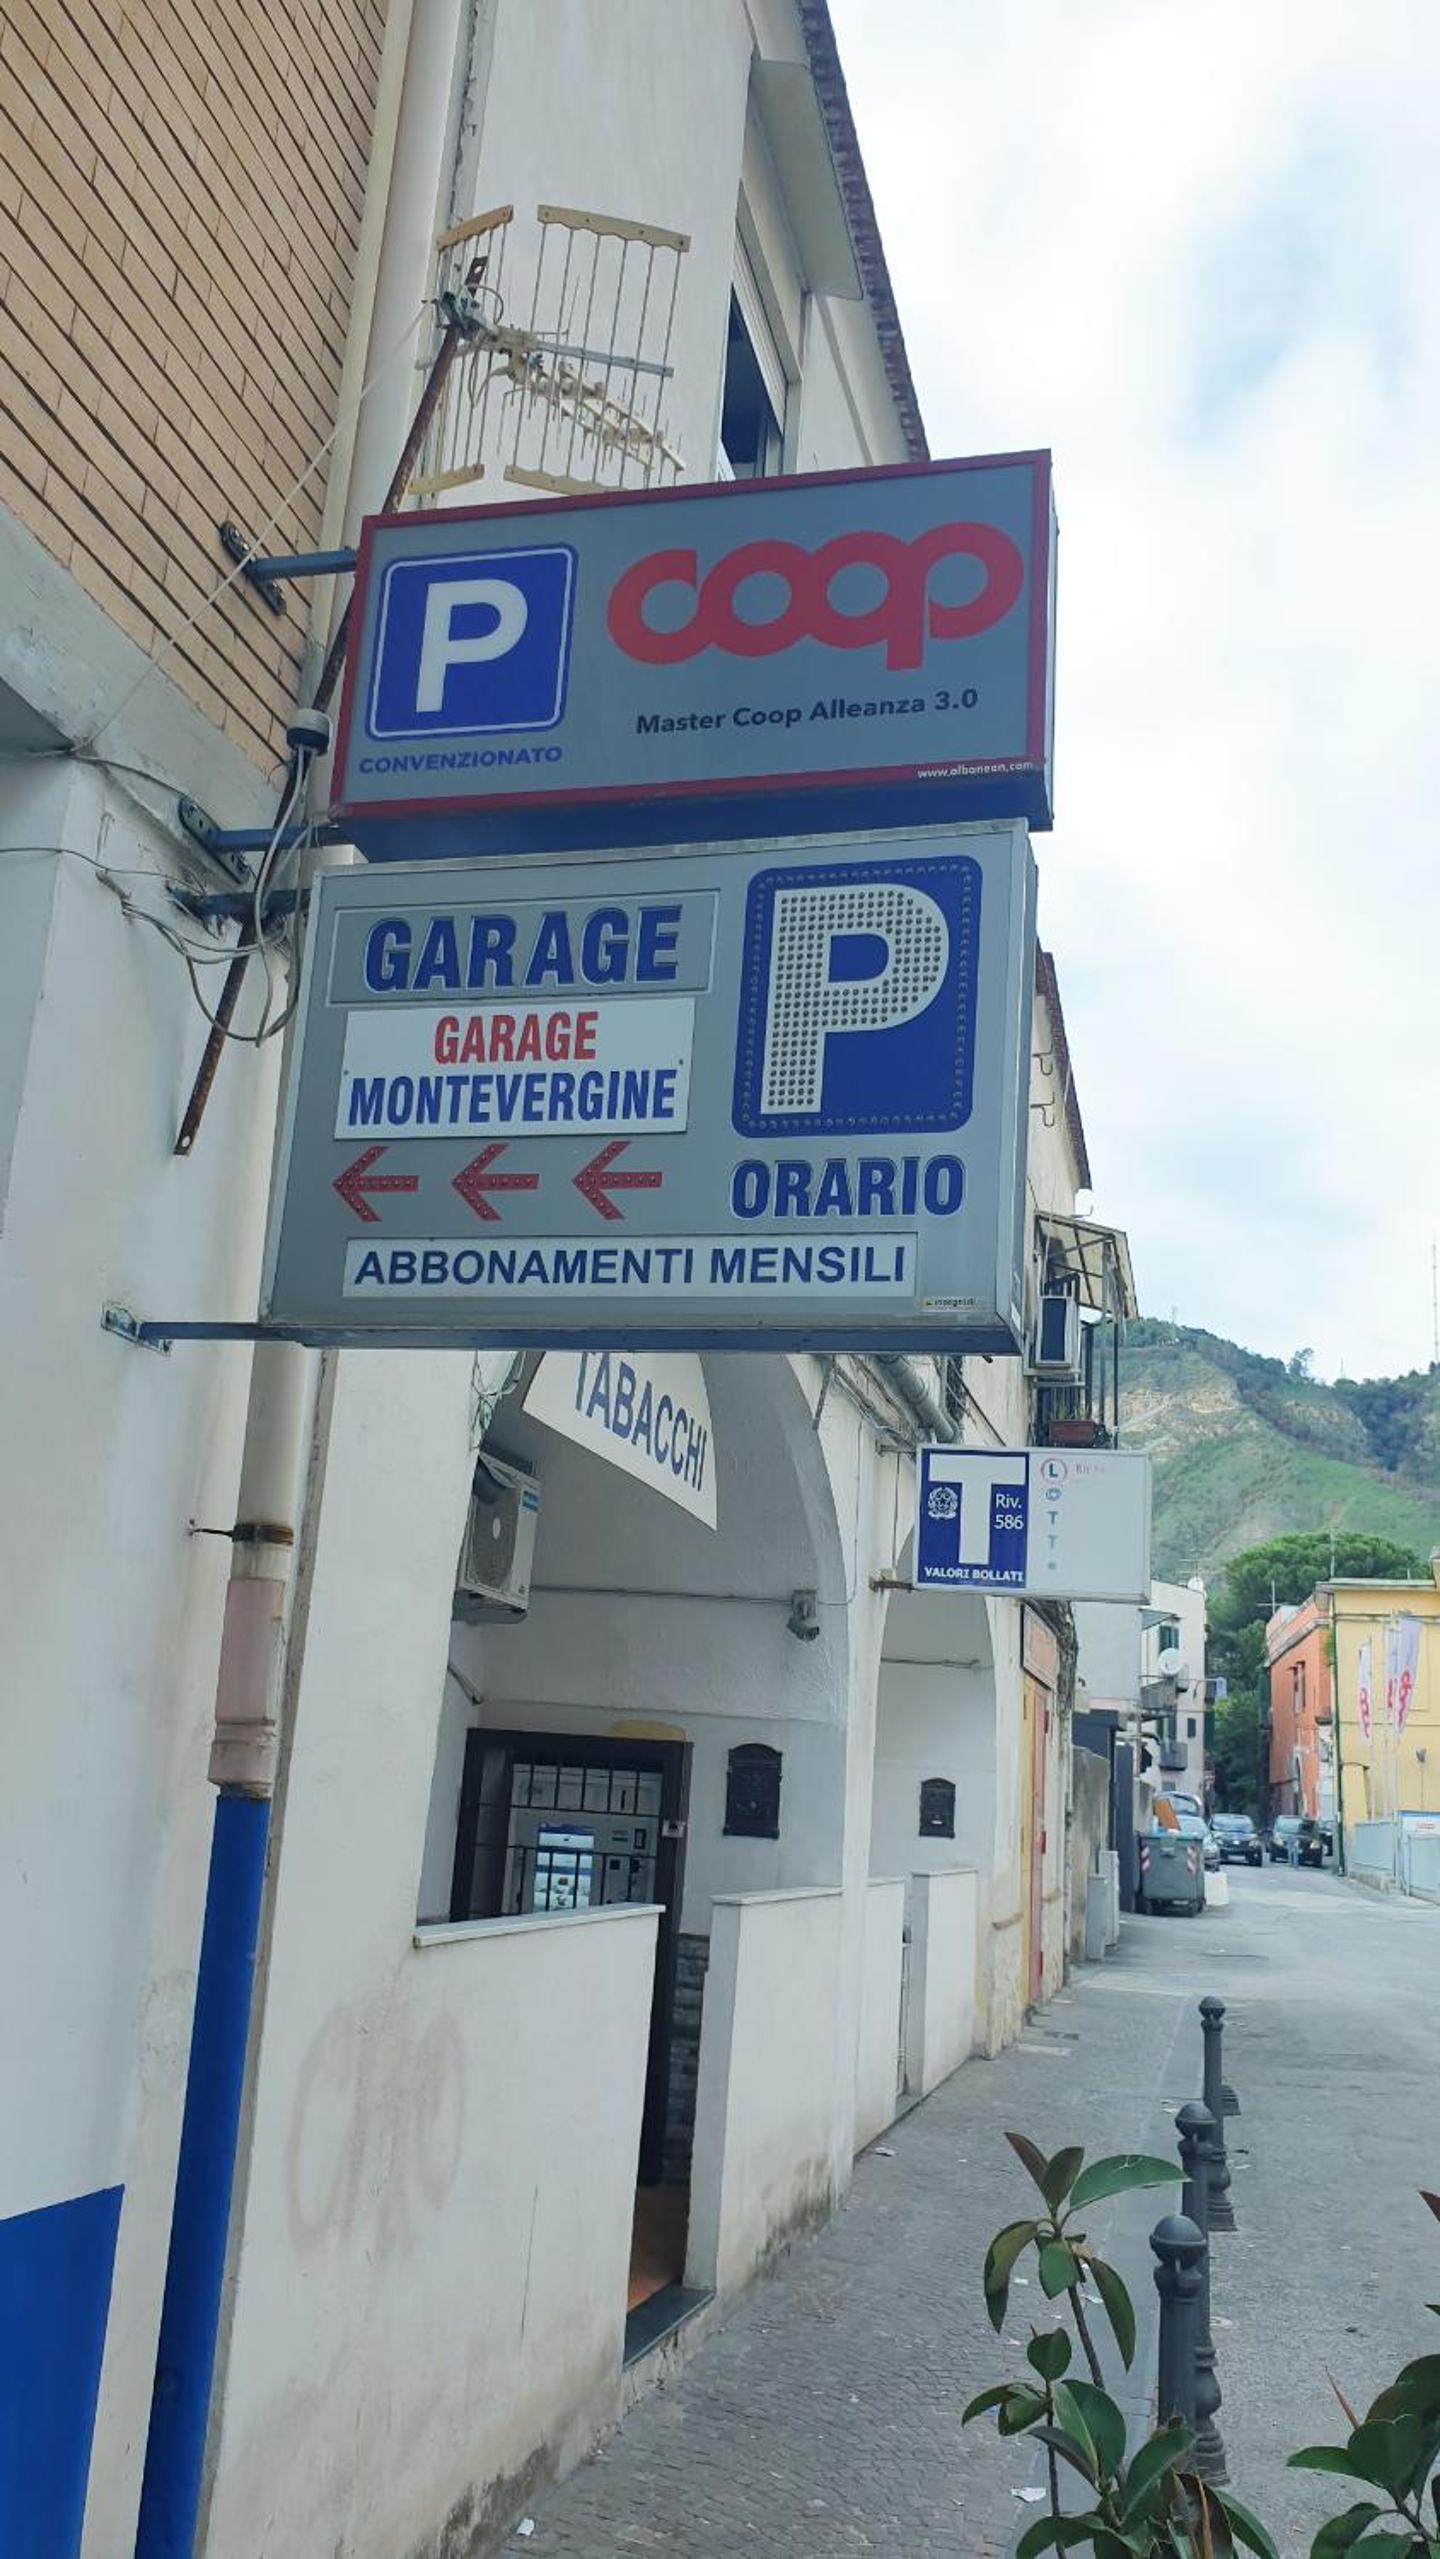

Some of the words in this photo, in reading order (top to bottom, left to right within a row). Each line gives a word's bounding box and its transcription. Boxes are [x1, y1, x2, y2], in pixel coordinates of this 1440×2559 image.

[606, 521, 1025, 672] coop
[415, 578, 529, 713] P
[635, 714, 727, 735] Master
[732, 706, 802, 728] Coop
[809, 697, 926, 721] Alleanza
[934, 688, 979, 711] 3.0
[359, 745, 563, 774] CONVENZIONATO
[363, 903, 684, 993] GARAGE
[759, 882, 951, 1116] P
[432, 1010, 600, 1064] GARAGE
[347, 1067, 678, 1127] MONTEVERGINE
[730, 1153, 968, 1220] ORARIO
[354, 1246, 695, 1287] ABBONAMENTI
[708, 1245, 906, 1284] MENSILI
[575, 1351, 707, 1492] TABACCHI
[928, 1453, 1027, 1565] T
[993, 1514, 1024, 1531] 586
[995, 1492, 1022, 1510] Riv.
[924, 1566, 970, 1580] VALORI
[972, 1568, 1024, 1583] BOLLATI
